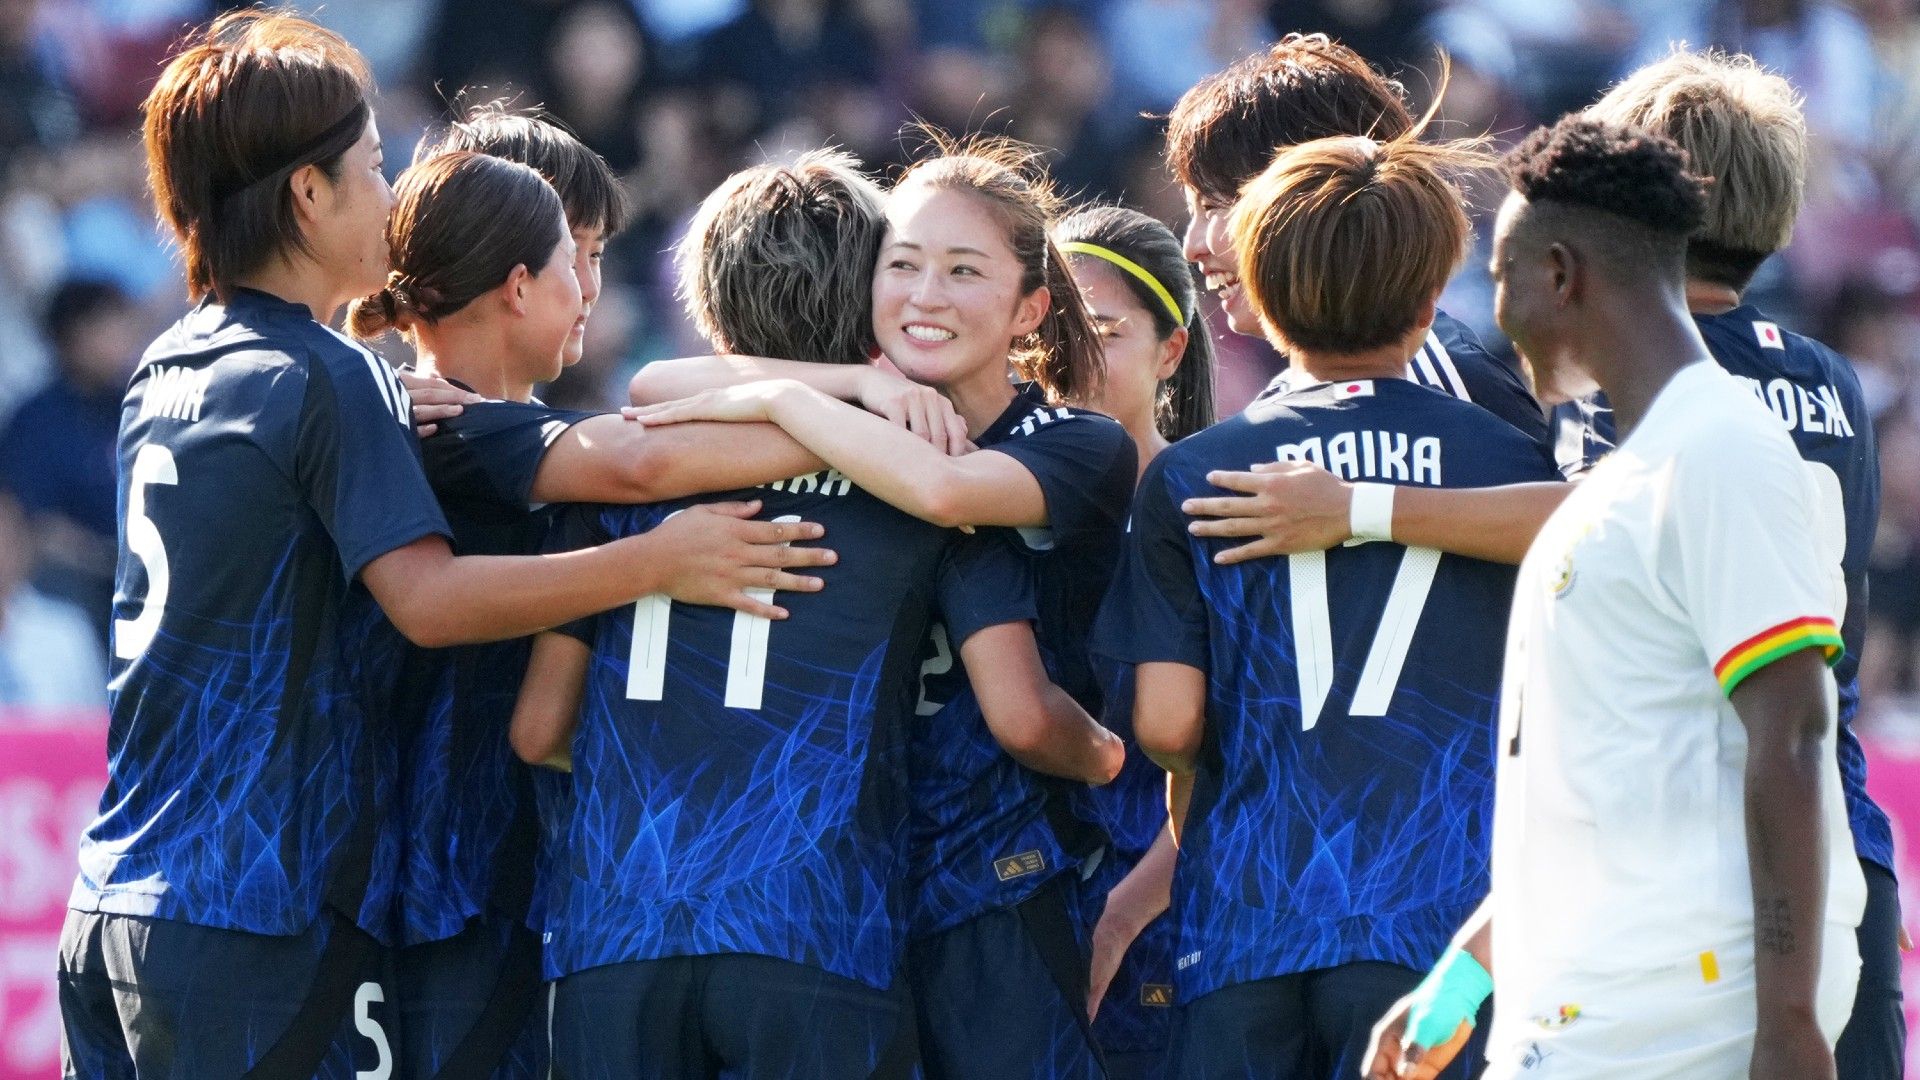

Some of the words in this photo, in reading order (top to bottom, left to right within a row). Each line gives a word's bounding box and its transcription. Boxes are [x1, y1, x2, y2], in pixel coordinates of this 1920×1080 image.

[1276, 430, 1441, 485] MAIKA
[114, 444, 179, 659] 5
[354, 982, 393, 1080] 5
